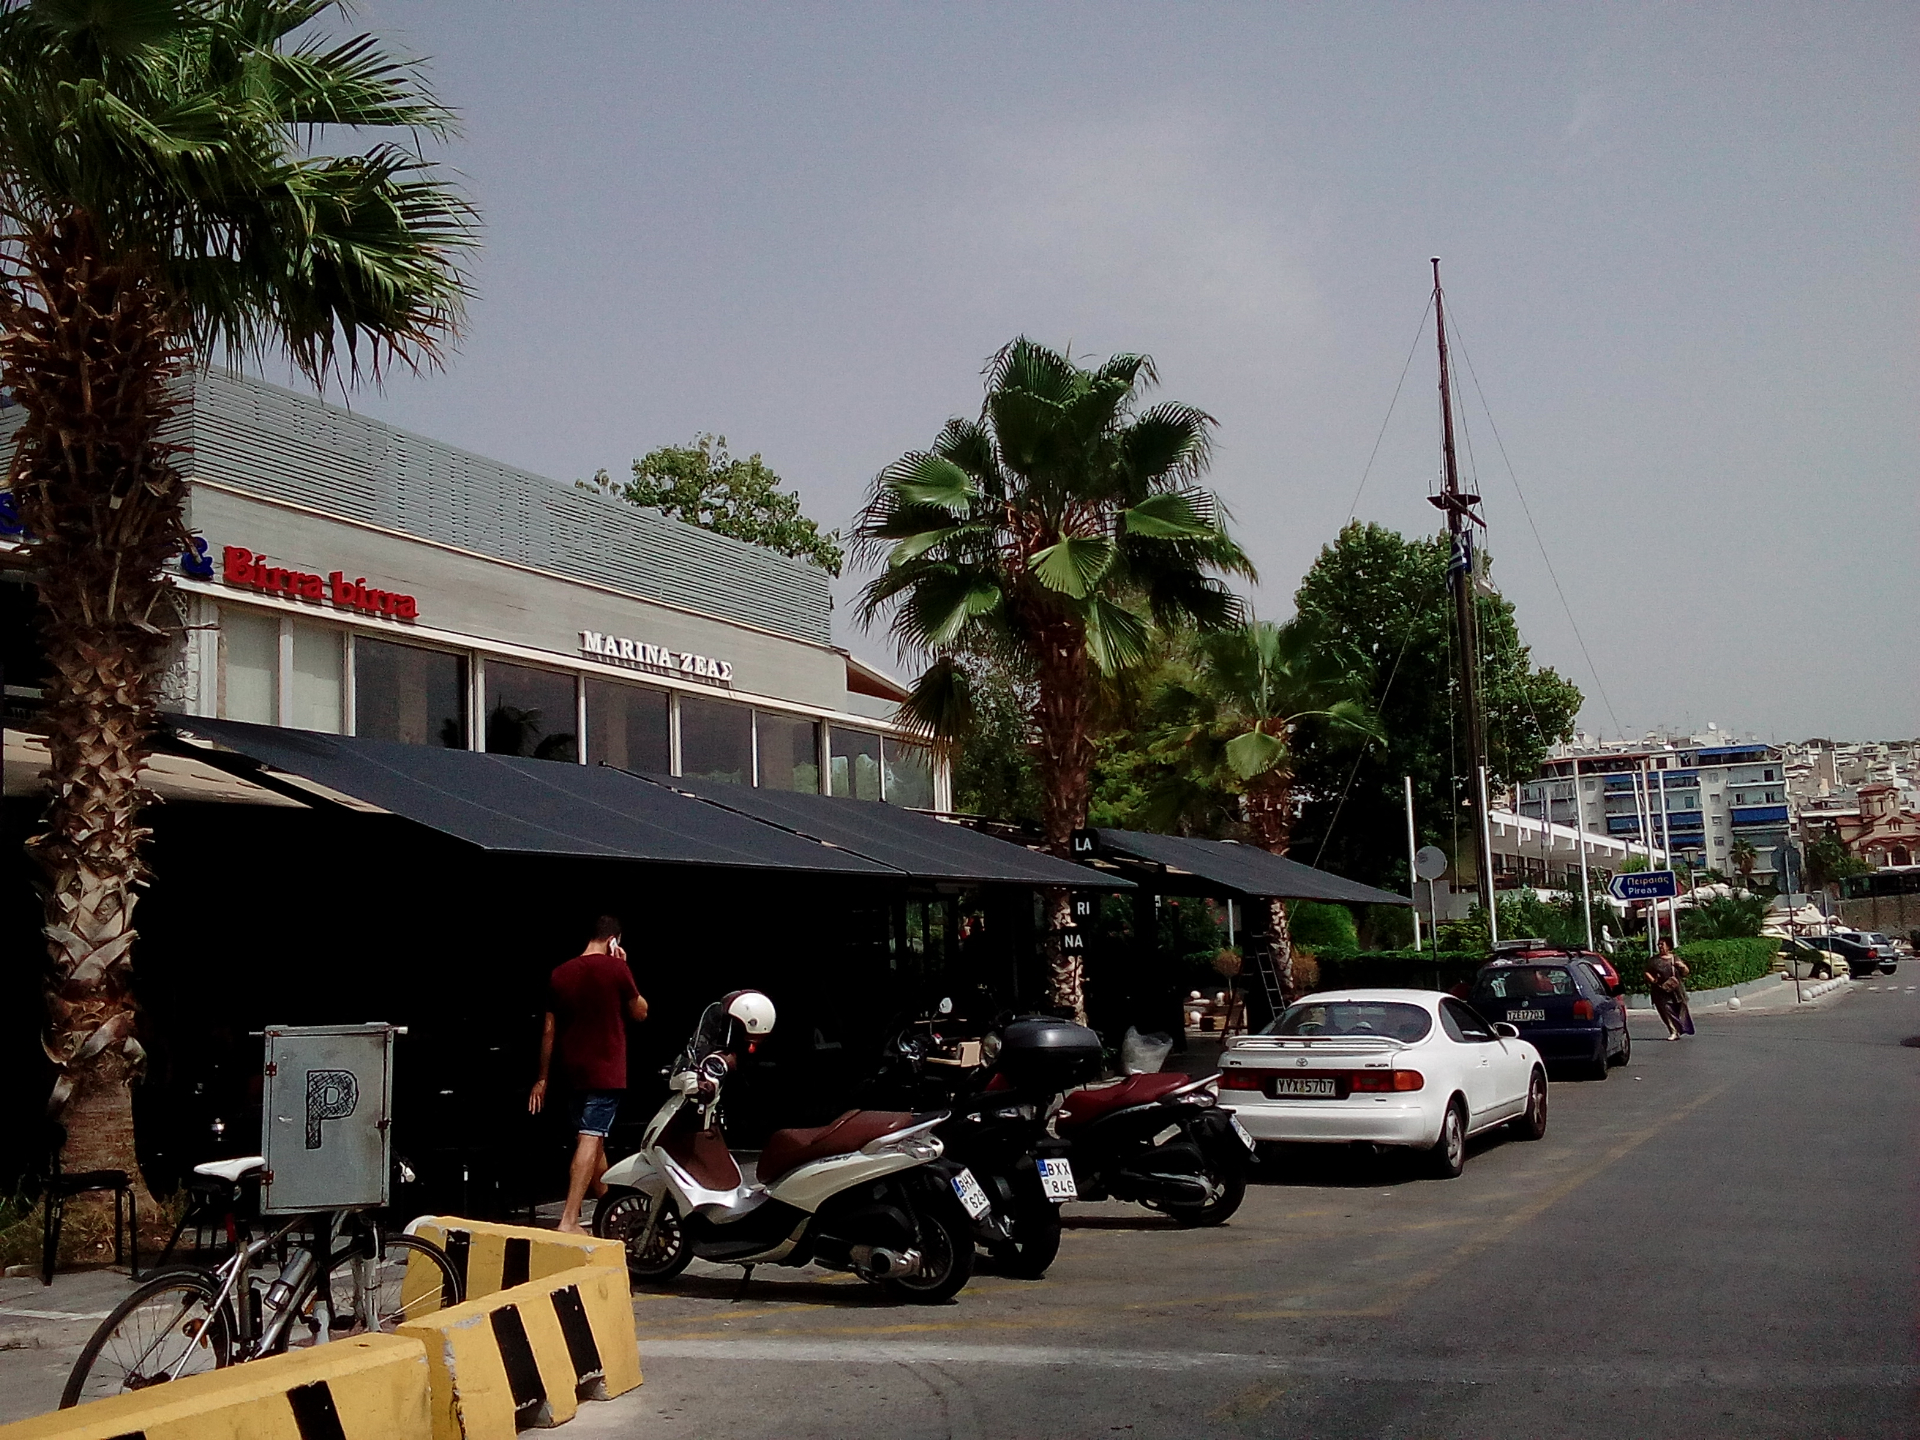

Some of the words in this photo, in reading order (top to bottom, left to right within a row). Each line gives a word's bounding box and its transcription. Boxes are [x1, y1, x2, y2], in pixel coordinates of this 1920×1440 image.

[223, 545, 326, 599] Birra
[329, 571, 419, 618] birra
[583, 630, 673, 668] MARINA
[1075, 837, 1093, 851] LA
[1627, 876, 1669, 887] Πειραιάς
[1628, 887, 1658, 895] Pireas
[1077, 902, 1090, 915] RI
[1064, 934, 1083, 948] NA
[306, 1069, 359, 1150] P
[1048, 1162, 1070, 1176] BXX
[958, 1171, 974, 1193] BHX
[1052, 1180, 1075, 1193] 846
[969, 1189, 986, 1209] 629
